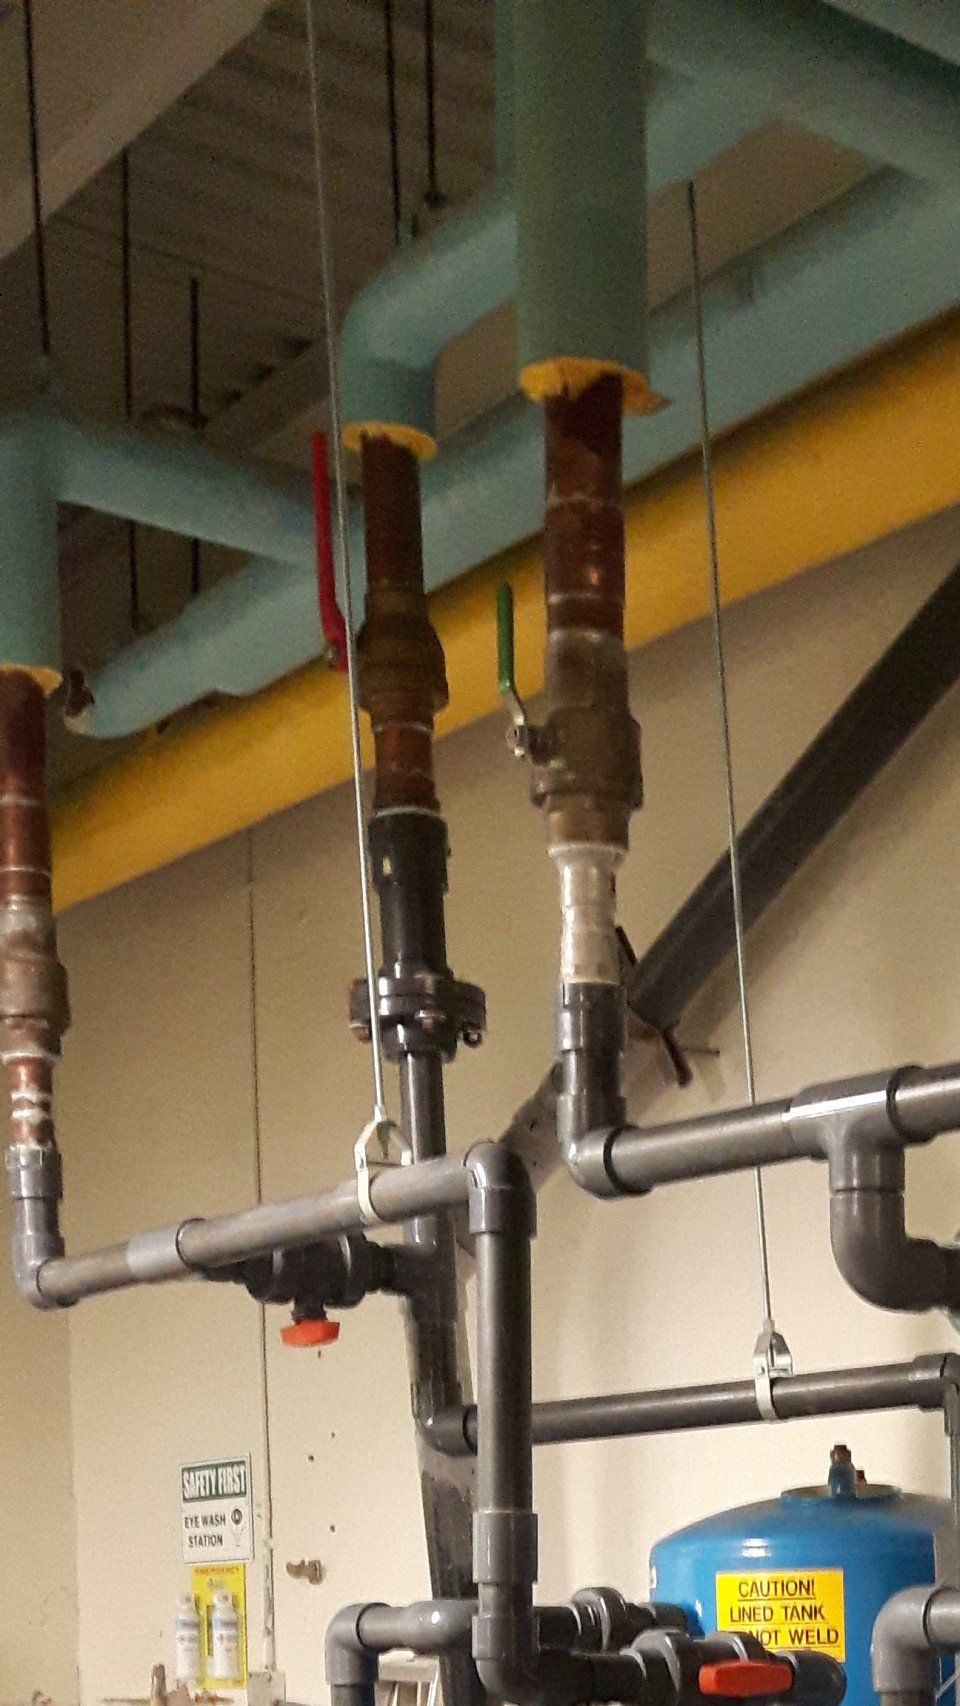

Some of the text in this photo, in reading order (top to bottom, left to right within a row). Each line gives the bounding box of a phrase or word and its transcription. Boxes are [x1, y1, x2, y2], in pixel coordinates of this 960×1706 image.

[183, 1463, 246, 1500] SAFETY FIRST
[184, 1514, 226, 1529] EYE WASH
[188, 1535, 223, 1548] STATION
[738, 1579, 815, 1598] CAUTION!
[730, 1604, 825, 1623] LINED TANK
[788, 1628, 839, 1646] WELD
